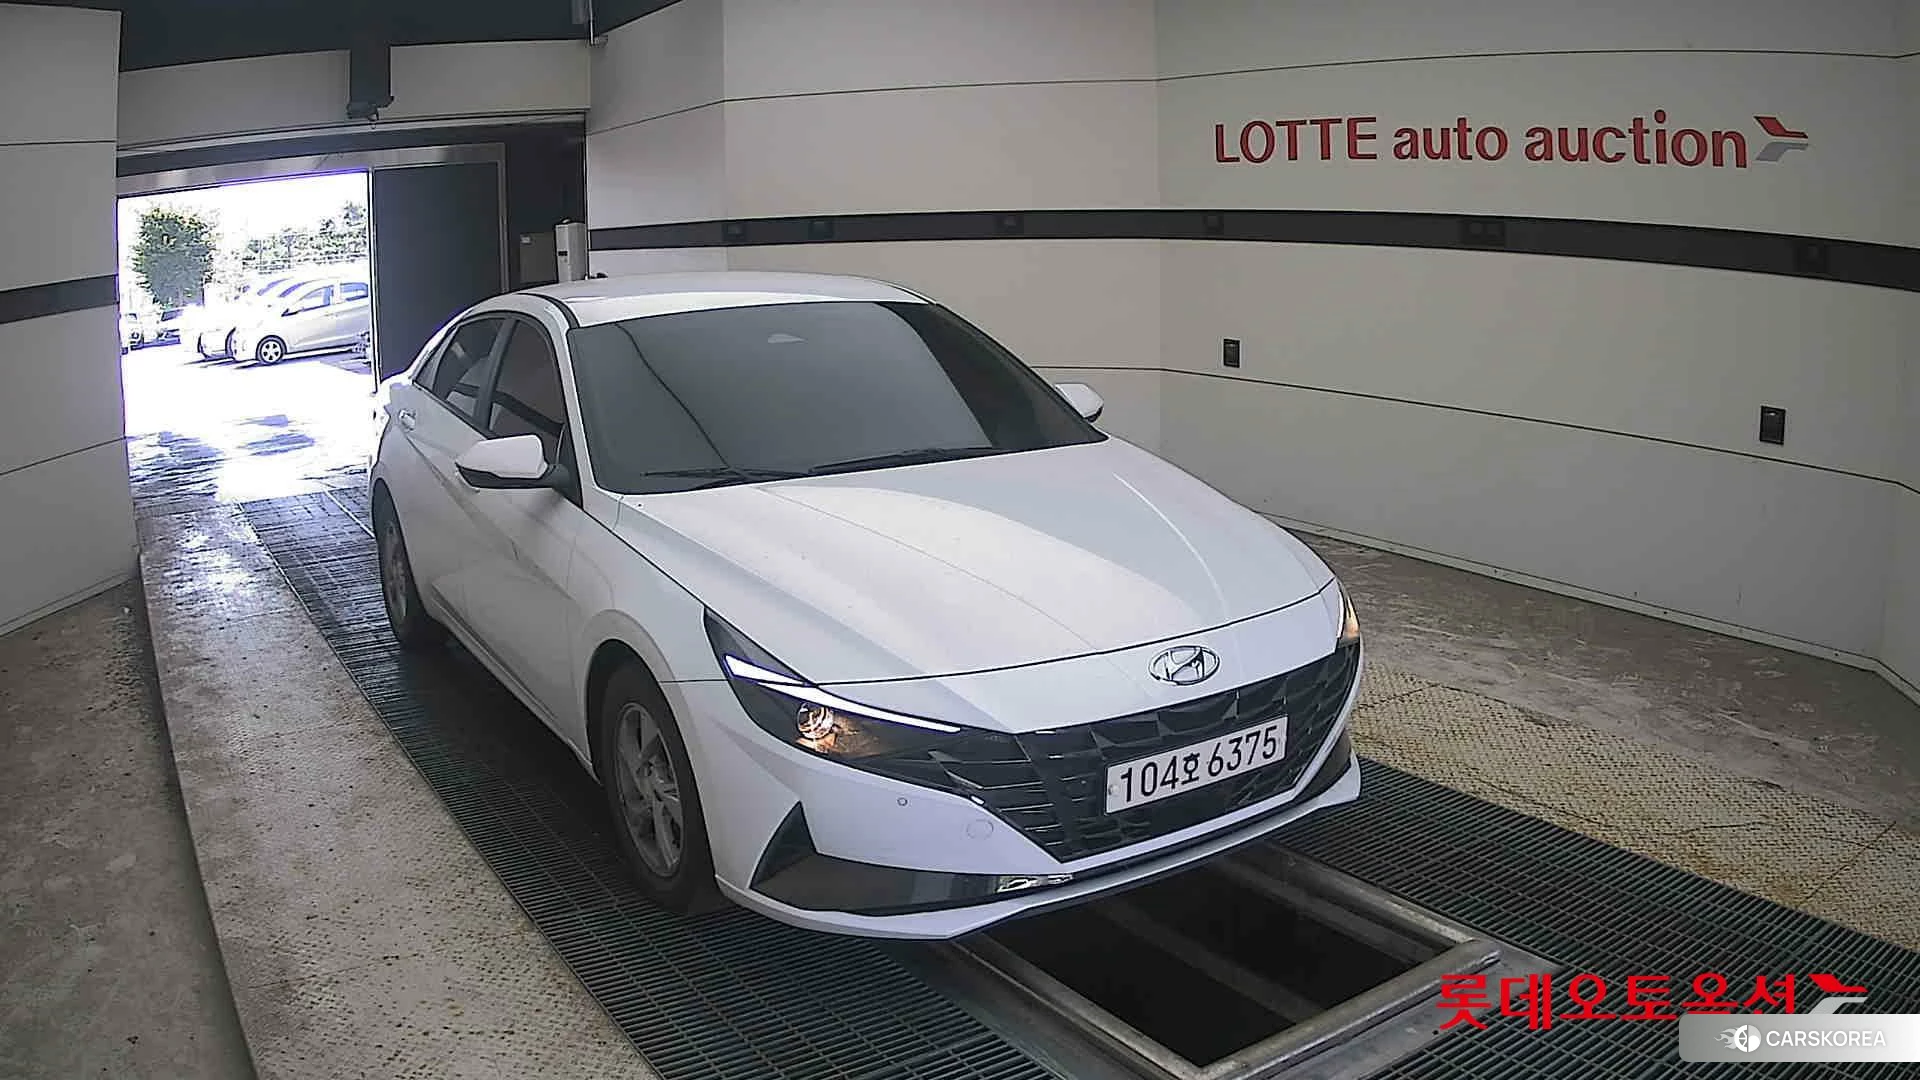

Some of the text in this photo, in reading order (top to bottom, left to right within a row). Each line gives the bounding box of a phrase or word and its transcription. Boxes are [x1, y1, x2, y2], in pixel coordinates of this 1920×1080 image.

[1215, 110, 1747, 168] LOTTE auto auction
[1121, 725, 1277, 803] 104호 6375
